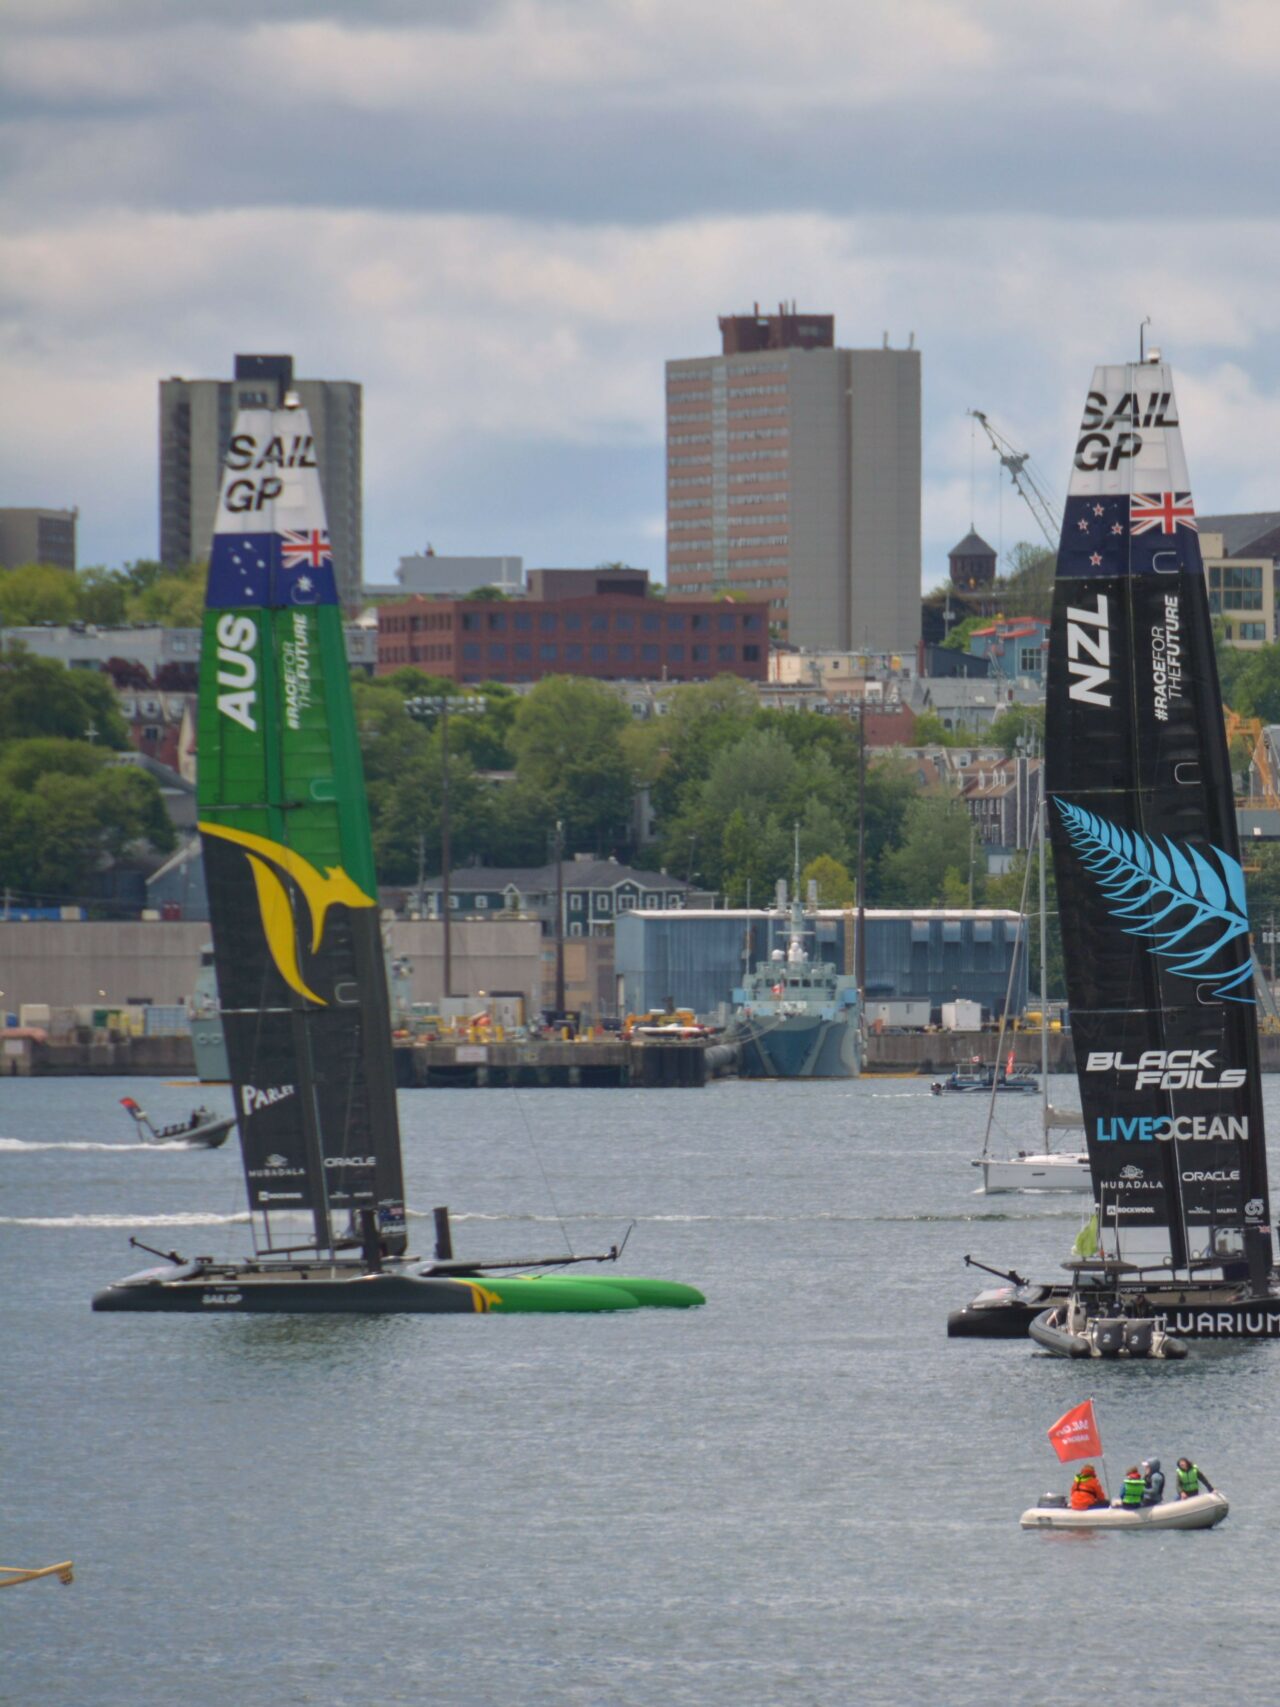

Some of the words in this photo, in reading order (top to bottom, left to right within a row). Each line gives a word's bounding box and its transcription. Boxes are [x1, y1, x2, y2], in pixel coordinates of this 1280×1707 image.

[1081, 391, 1179, 430] SAIL
[226, 434, 318, 469] SAIL
[1074, 432, 1142, 471] GP
[225, 477, 283, 513] GP
[1067, 594, 1111, 707] NZL
[217, 614, 257, 732] AUS
[1086, 1049, 1218, 1072] BLACK
[1135, 1068, 1247, 1091] FOILS
[323, 1156, 376, 1168] ORACLE
[1182, 1170, 1240, 1182] ORACLE
[1101, 1181, 1164, 1189] MUBADALA
[1103, 1333, 1112, 1343] 2
[1131, 1335, 1139, 1345] 2
